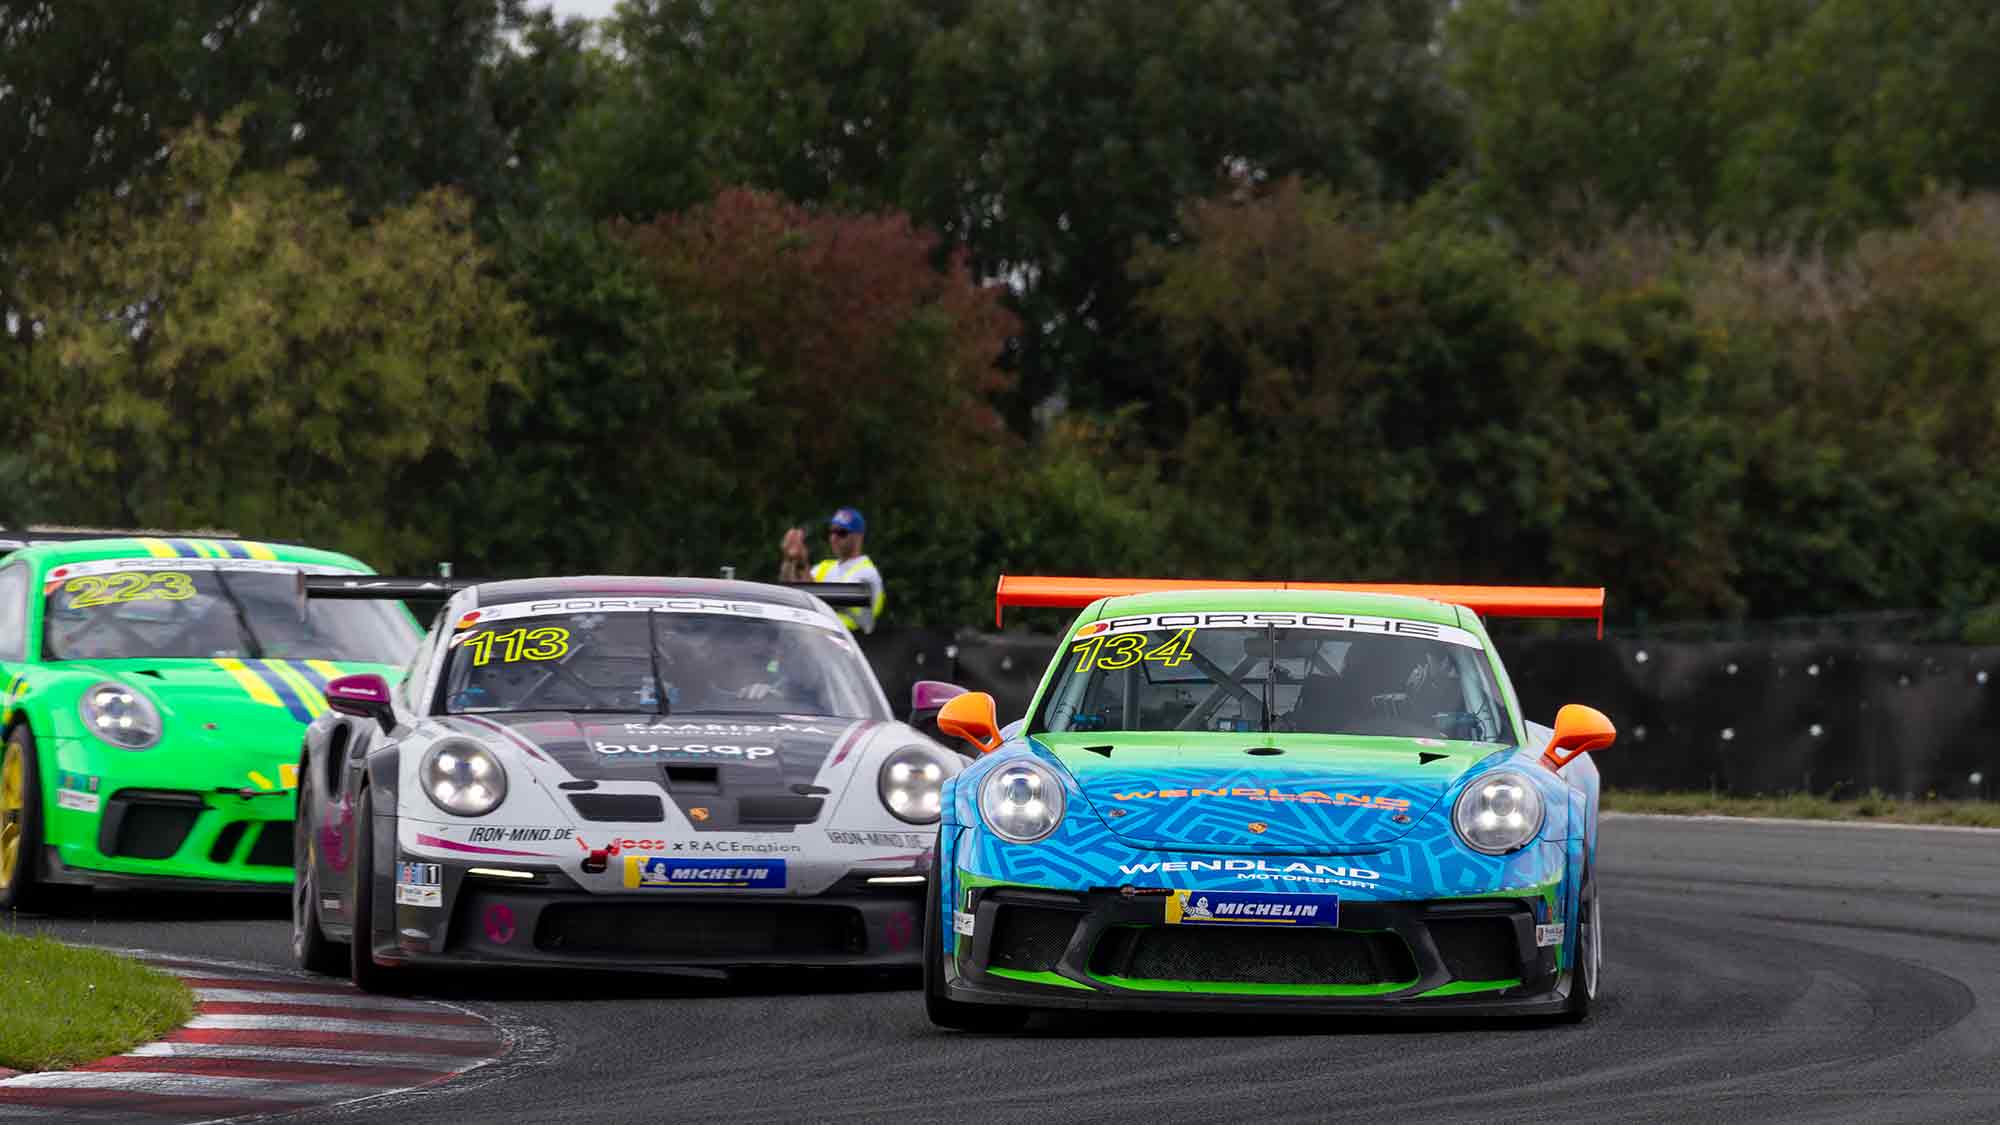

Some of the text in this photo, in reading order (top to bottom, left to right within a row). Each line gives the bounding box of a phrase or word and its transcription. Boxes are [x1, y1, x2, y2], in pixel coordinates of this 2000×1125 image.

[64, 571, 198, 609] 223
[531, 601, 763, 615] PORSCHE
[1109, 614, 1440, 638] PORSCHE
[463, 627, 570, 667] 113
[1072, 627, 1197, 673] 134
[595, 742, 776, 760] bu-cap
[1112, 787, 1411, 807] WENDLAND
[468, 827, 576, 842] IRON-MIND.DE
[671, 867, 769, 880] MICHELIN
[1119, 859, 1381, 880] WENDLAND
[1236, 873, 1378, 889] MOTORSPORT
[1215, 902, 1319, 917] MICHELIN
